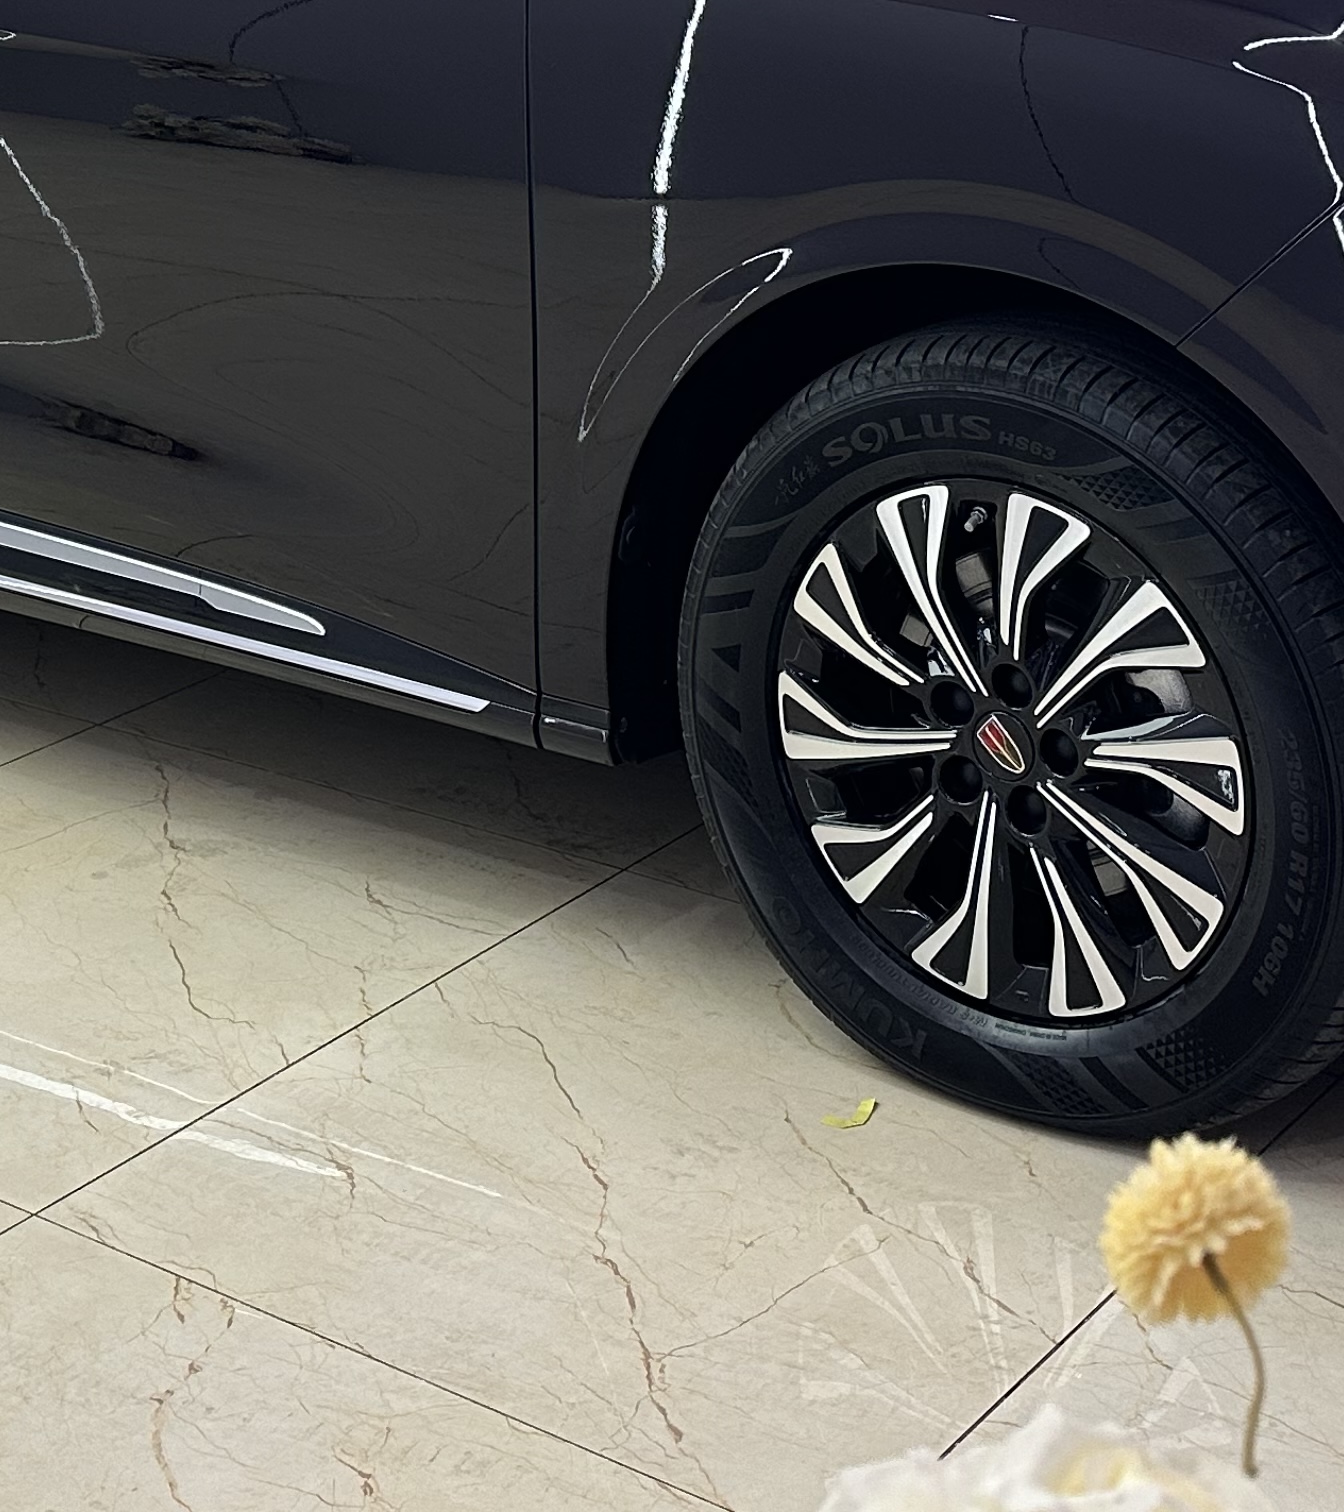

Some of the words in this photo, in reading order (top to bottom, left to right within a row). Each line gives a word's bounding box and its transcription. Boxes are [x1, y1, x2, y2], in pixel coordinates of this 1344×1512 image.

[821, 412, 993, 468] SOLUS
[997, 430, 1058, 462] HS63
[1277, 726, 1310, 845] 235/60
[771, 896, 928, 1062] KUMHO
[1251, 921, 1297, 999] 106H
